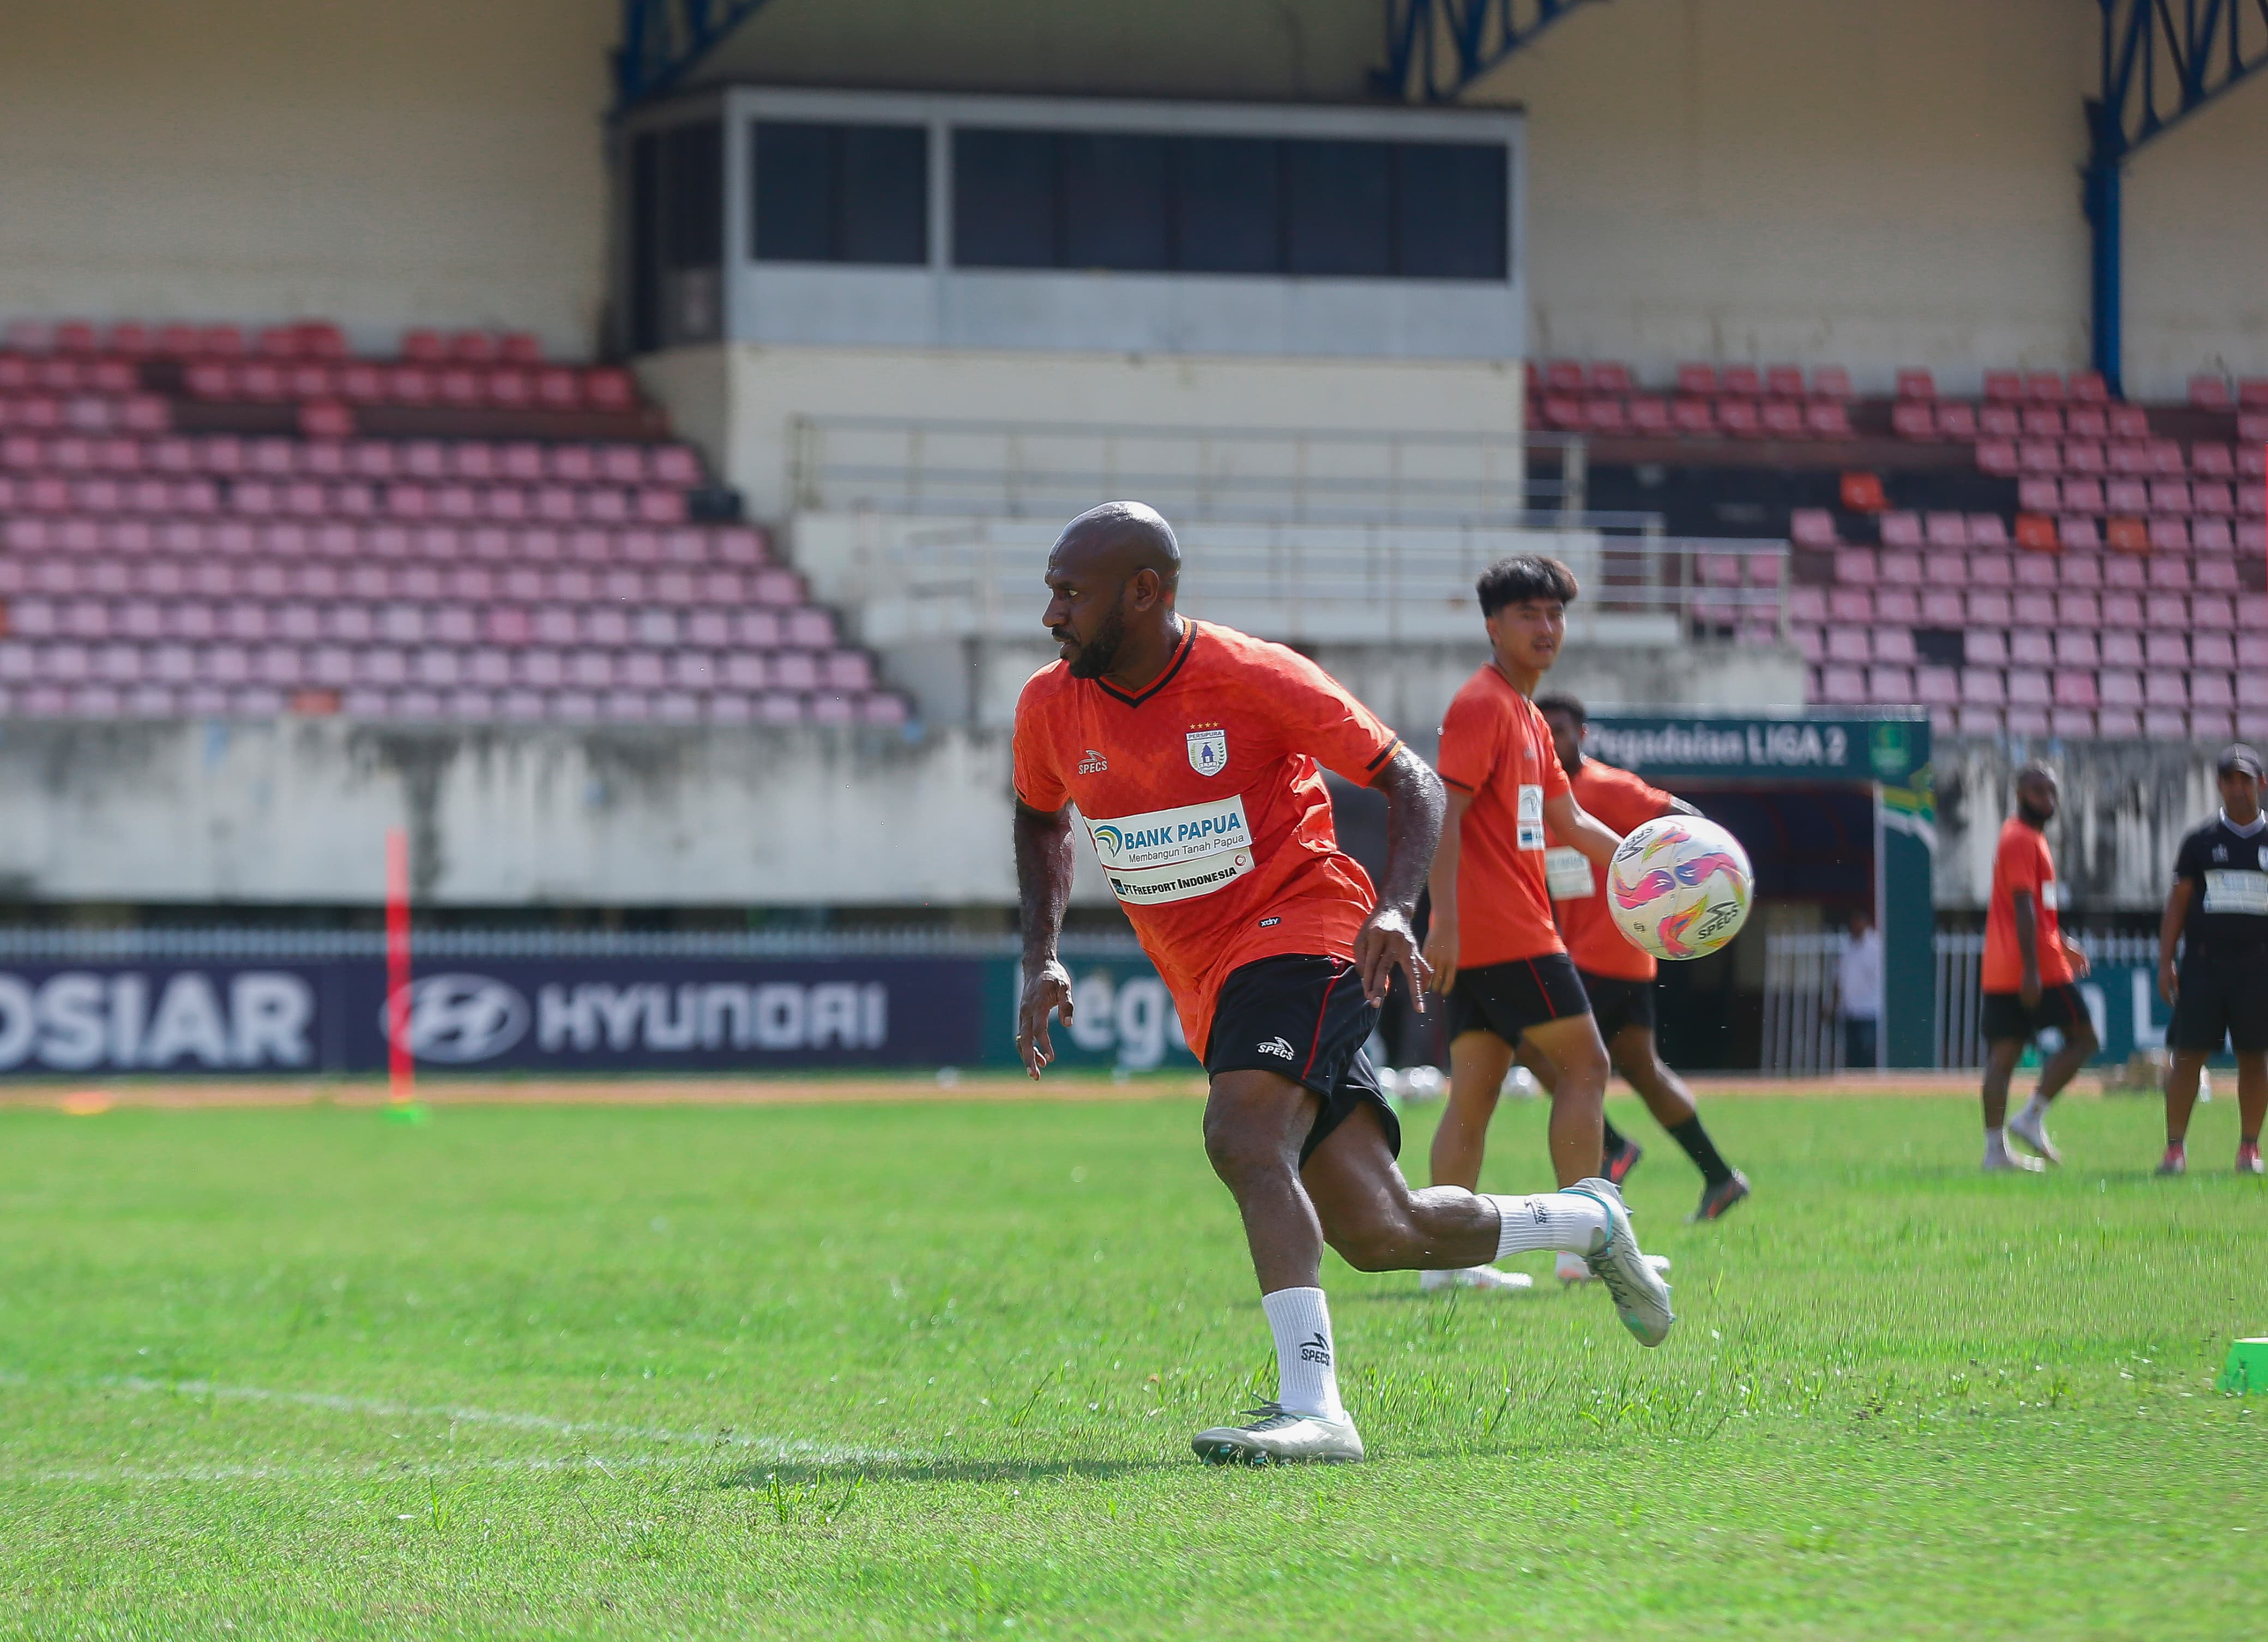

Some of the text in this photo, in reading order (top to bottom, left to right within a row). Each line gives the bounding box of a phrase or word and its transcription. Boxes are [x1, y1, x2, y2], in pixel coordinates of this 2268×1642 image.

[1747, 724, 1823, 766] LIGA
[1824, 725, 1848, 766] 2
[1078, 761, 1108, 774] SPECS
[1124, 813, 1241, 850] BANK PAPUA
[1129, 835, 1244, 863] Membangun Tanah Papua
[1124, 867, 1238, 895] PT FREEPORT INDONESIA
[1698, 905, 1739, 940] SPECS
[538, 982, 888, 1051] HYUNDAI
[1258, 1044, 1294, 1061] SPECS
[1301, 1348, 1330, 1367] SPECS
